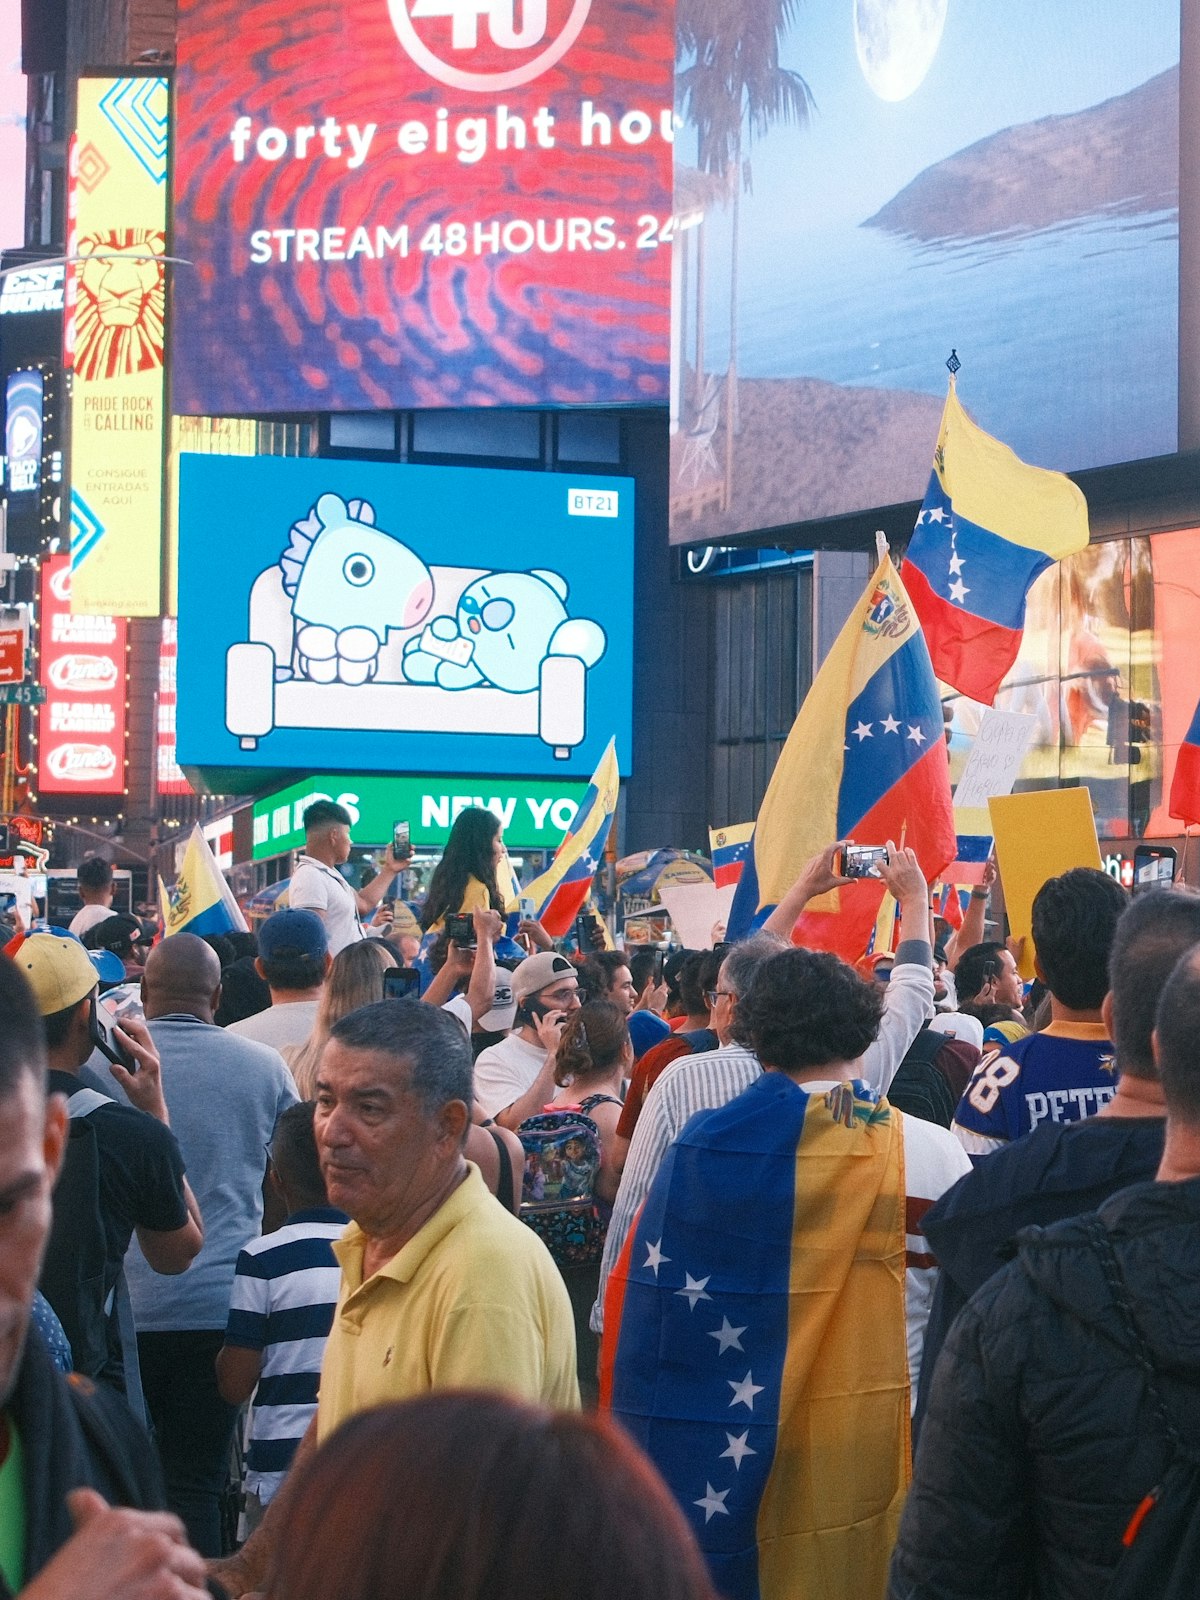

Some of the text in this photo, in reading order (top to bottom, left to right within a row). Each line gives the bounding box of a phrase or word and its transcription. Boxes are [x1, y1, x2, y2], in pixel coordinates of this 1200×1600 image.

[230, 116, 377, 169] forty
[398, 104, 555, 163] eight
[250, 225, 409, 263] STREAM
[84, 396, 153, 411] PRIDE ROCK
[95, 413, 153, 431] CALLING
[87, 469, 148, 478] CONSIGUE
[86, 482, 149, 492] ENTRADAS
[574, 495, 612, 511] BT21
[15, 687, 31, 702] 45
[1025, 1085, 1120, 1134] PETE
